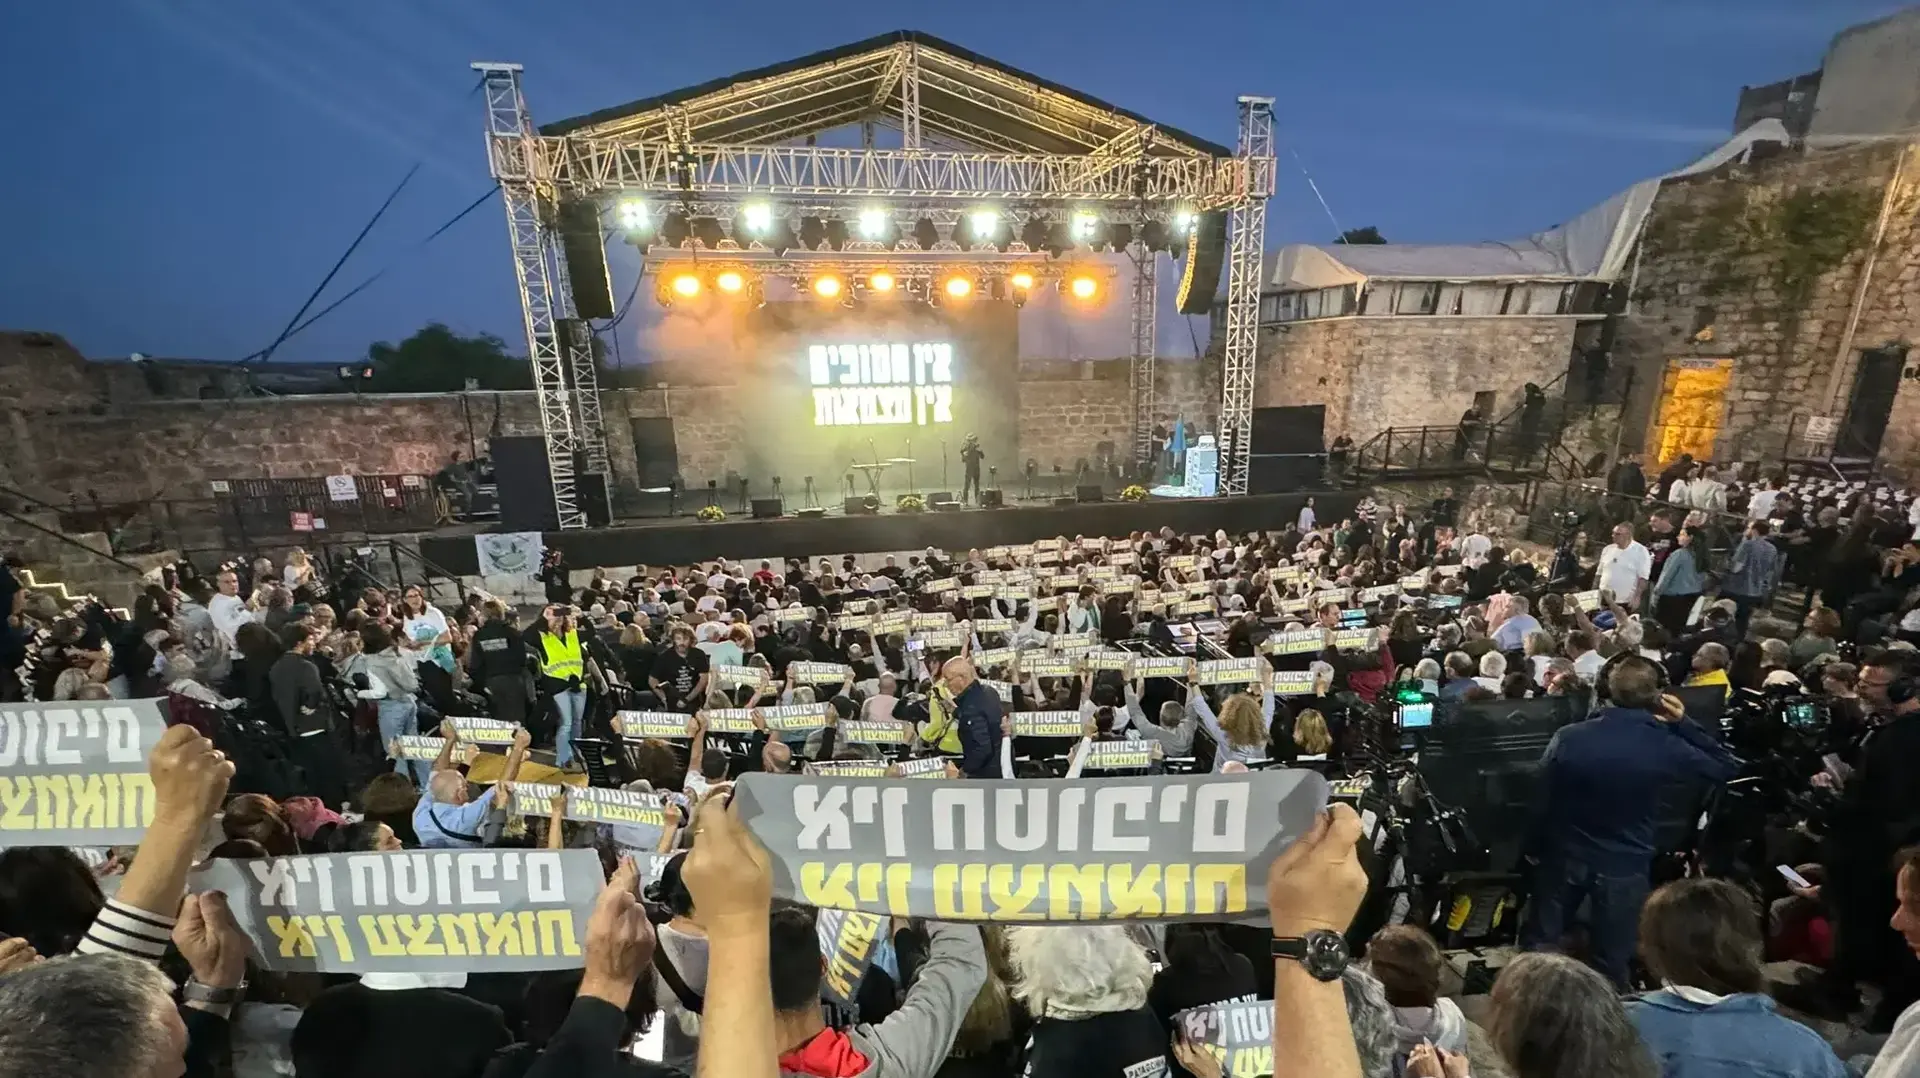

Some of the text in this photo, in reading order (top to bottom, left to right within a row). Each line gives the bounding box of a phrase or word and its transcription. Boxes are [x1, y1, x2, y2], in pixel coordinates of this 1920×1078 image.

[809, 343, 952, 385] אין חטופים
[812, 385, 953, 425] אין עצמאות
